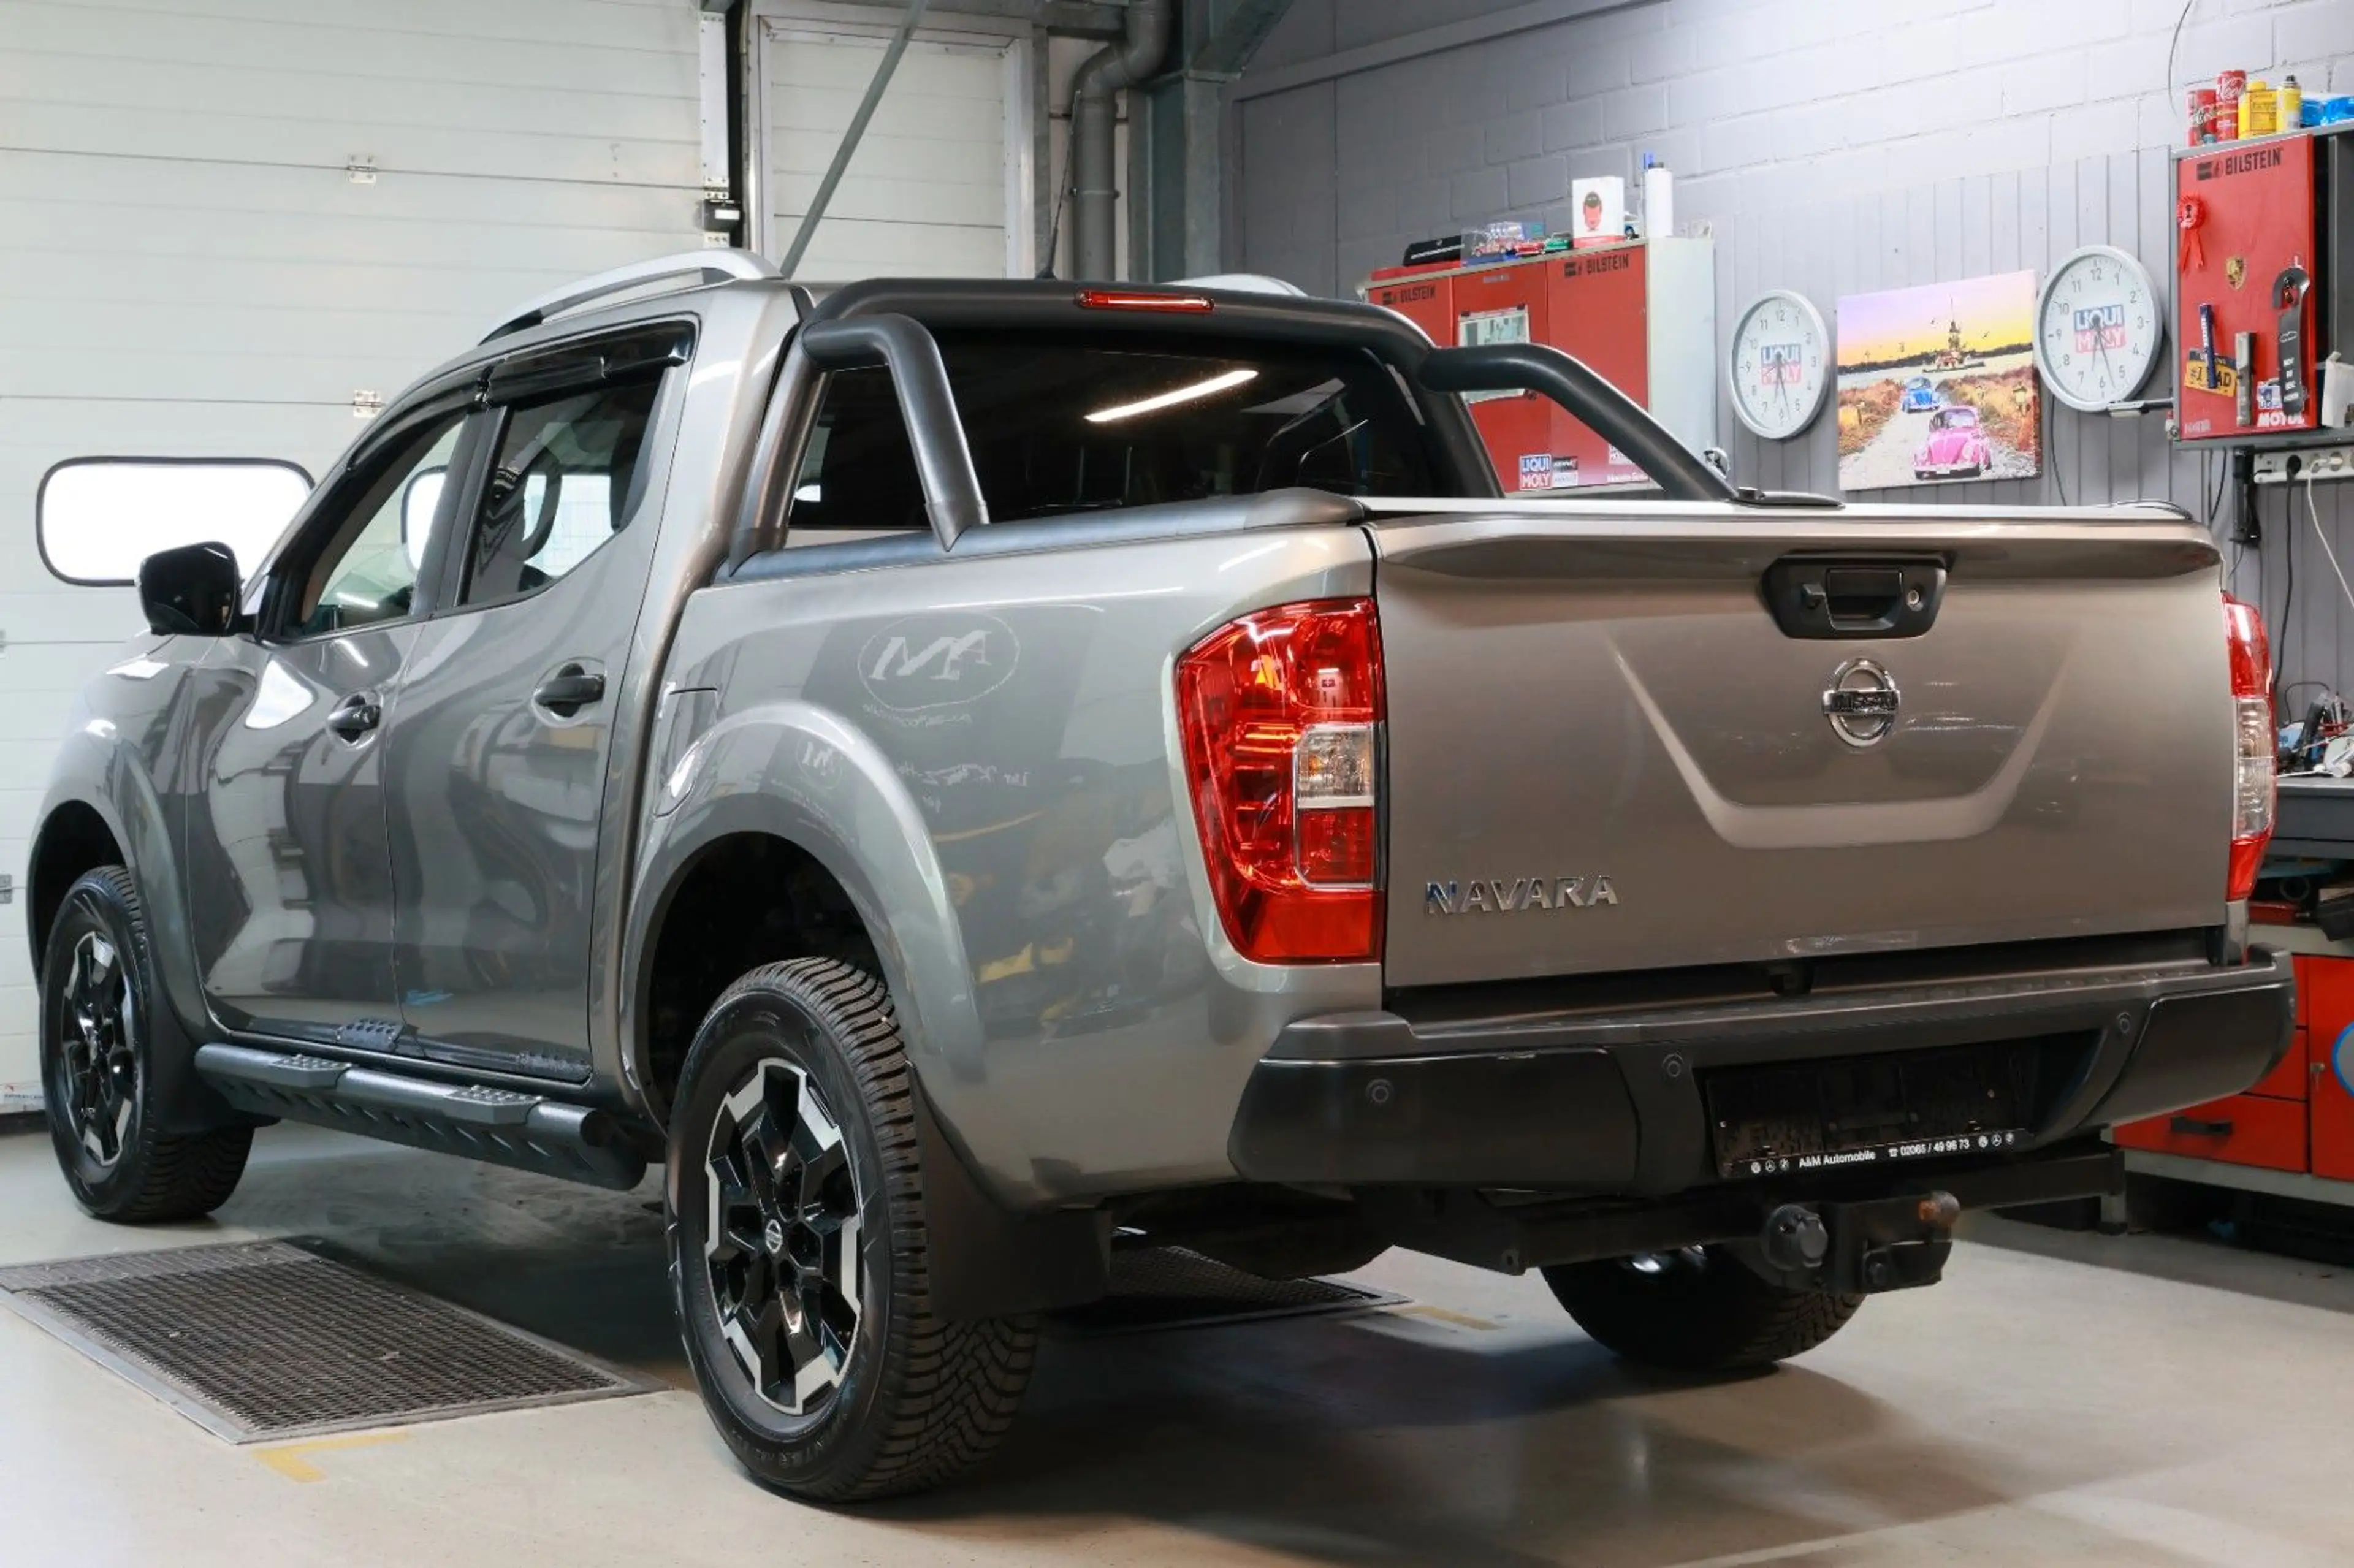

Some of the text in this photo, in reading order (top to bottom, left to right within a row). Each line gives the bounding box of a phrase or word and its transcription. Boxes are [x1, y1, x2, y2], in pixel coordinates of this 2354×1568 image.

[2226, 150, 2282, 175] BILSTEIN
[1586, 253, 1629, 275] BILSTEIN
[2090, 268, 2102, 281] 12
[2114, 273, 2120, 286] 1
[2072, 281, 2081, 292] 11
[1401, 285, 1436, 304] BILSTEIN
[2130, 291, 2136, 303] 2
[2060, 299, 2070, 315] 10
[1761, 319, 1768, 330] 11
[2075, 305, 2124, 331] LIQUI
[2137, 316, 2144, 329] 3
[2056, 329, 2062, 340] 9
[2133, 343, 2139, 356] 4
[2063, 354, 2070, 366] 8
[2078, 371, 2084, 383] 7
[2119, 365, 2125, 378] 5
[2099, 376, 2105, 387] 6
[1521, 457, 1550, 472] LIQUI
[1521, 473, 1550, 488] MOLY
[1424, 875, 1620, 915] NAVARA
[1799, 1156, 1821, 1168] A&M
[1823, 1149, 1876, 1166] Automobile
[1933, 1142, 1945, 1153] 49
[1959, 1139, 1970, 1150] 73
